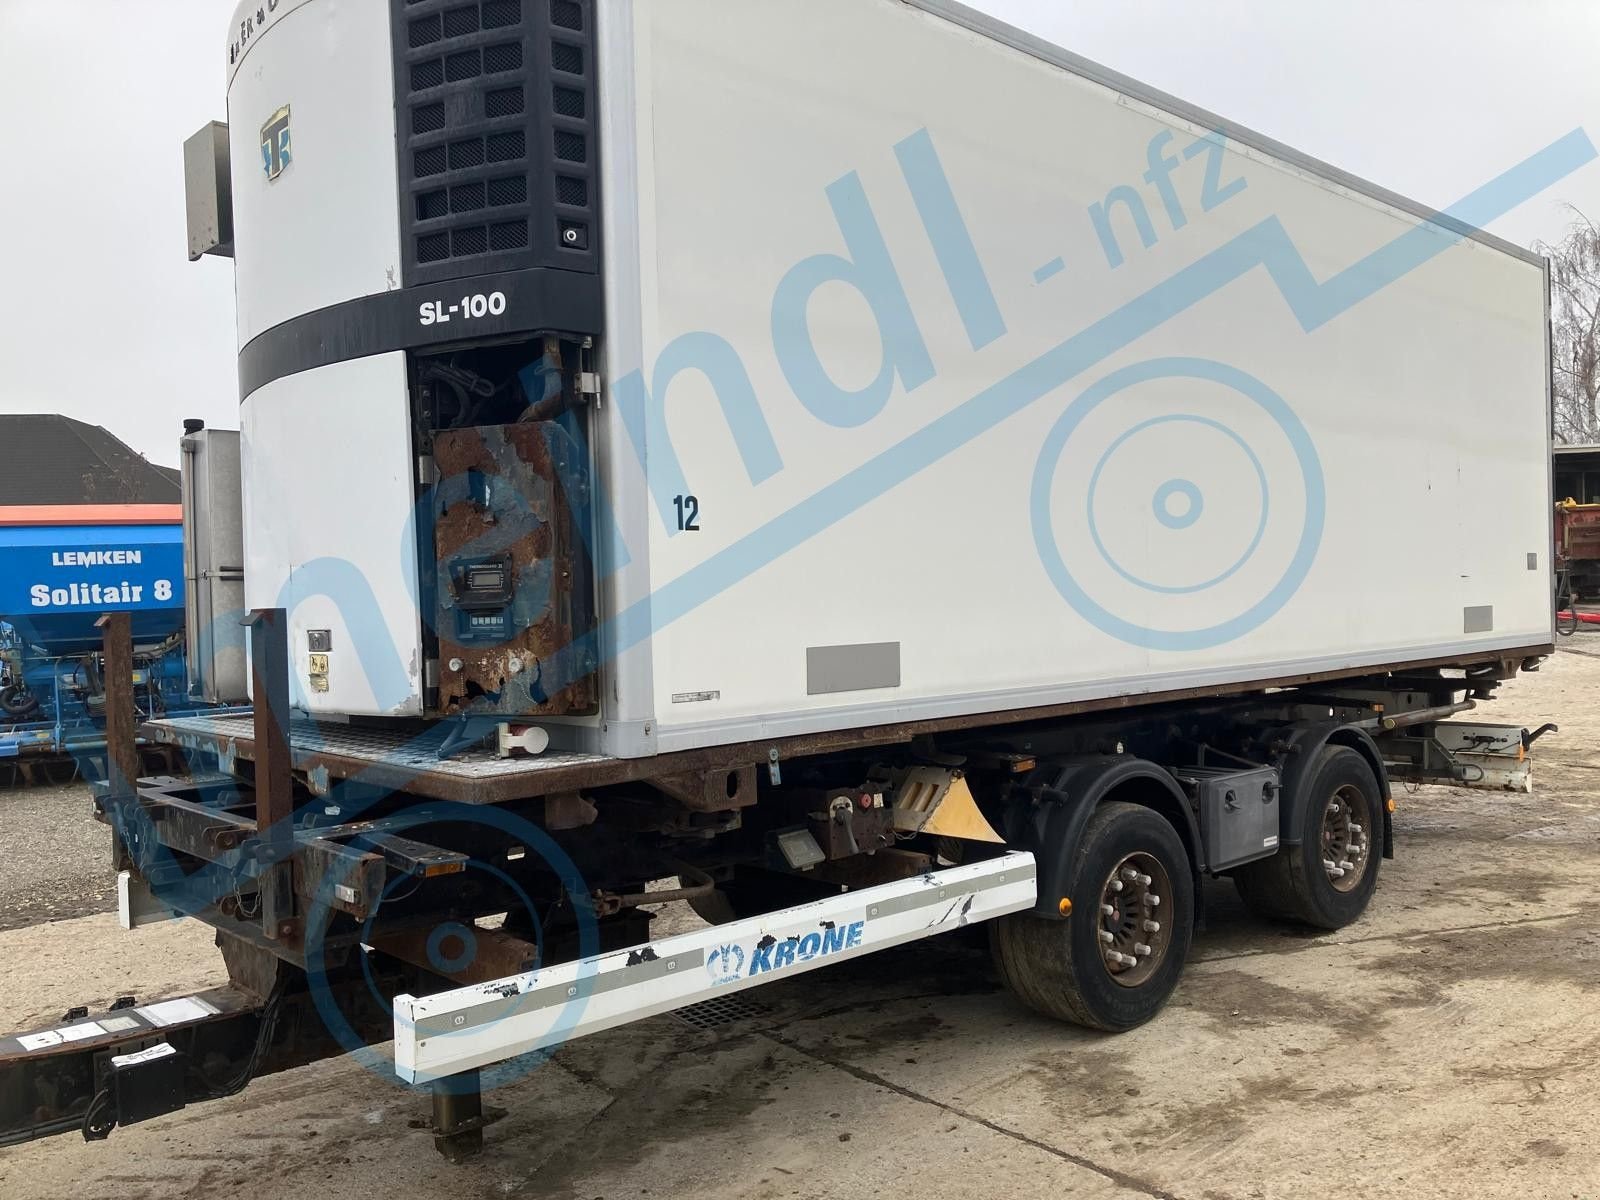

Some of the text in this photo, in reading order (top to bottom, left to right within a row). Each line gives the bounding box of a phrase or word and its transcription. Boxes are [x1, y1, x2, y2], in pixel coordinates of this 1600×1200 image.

[420, 291, 506, 326] SL-100
[673, 494, 700, 531] 12
[52, 550, 142, 569] LEMKEN
[30, 579, 173, 607] Solitair 8
[749, 920, 865, 977] KRONE
